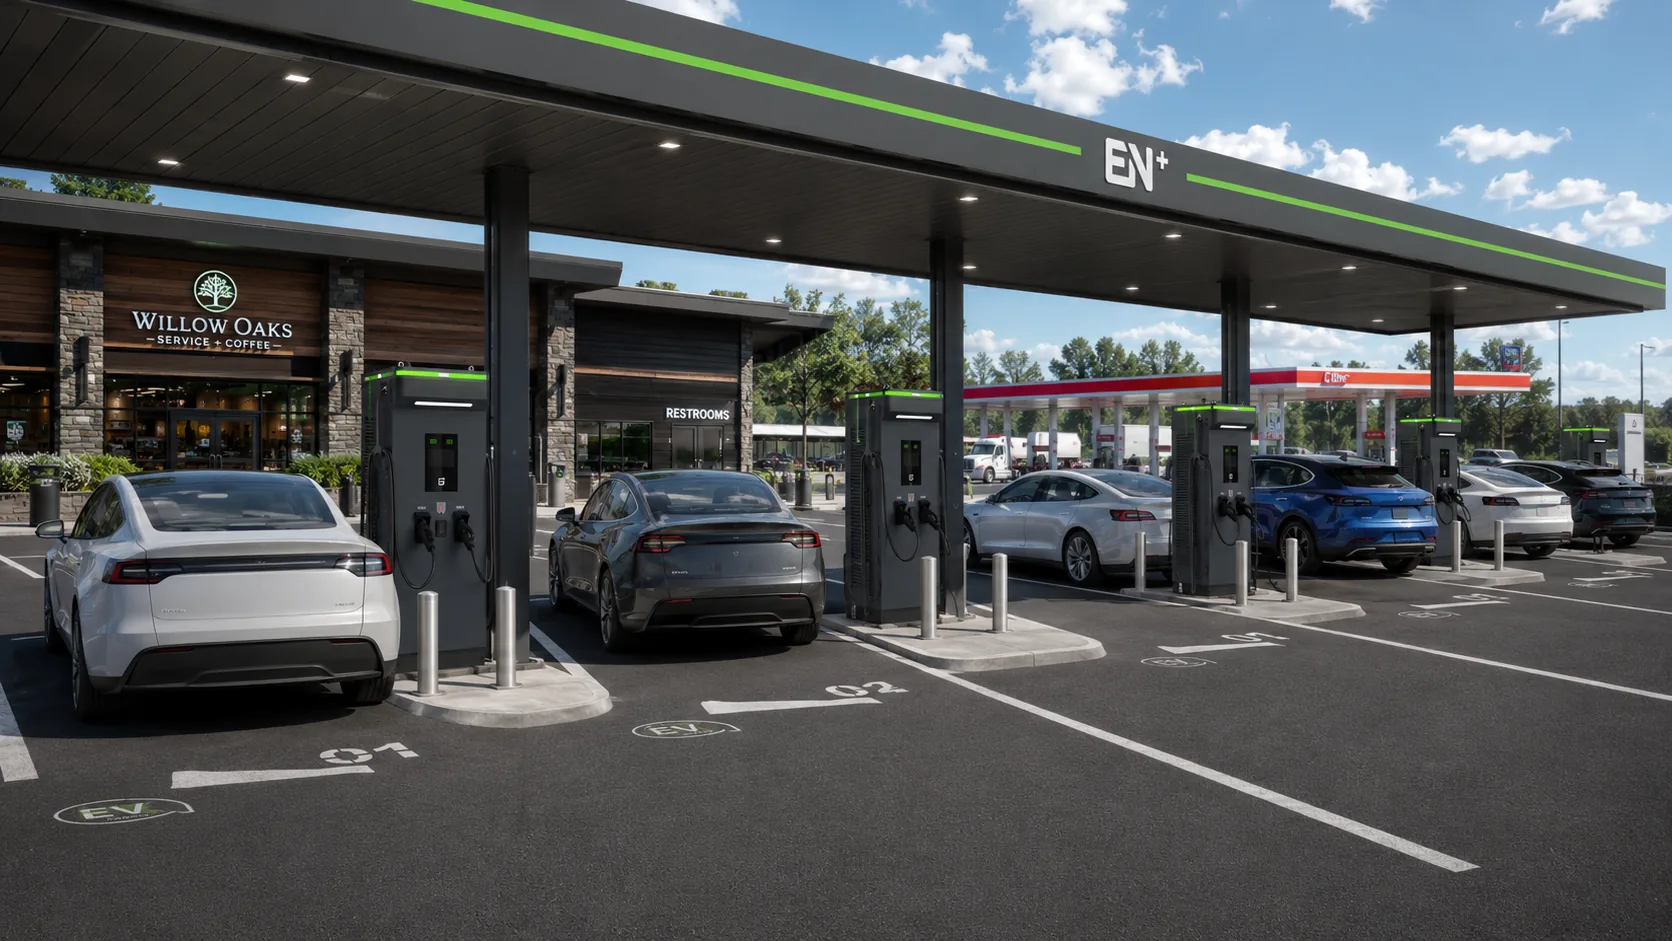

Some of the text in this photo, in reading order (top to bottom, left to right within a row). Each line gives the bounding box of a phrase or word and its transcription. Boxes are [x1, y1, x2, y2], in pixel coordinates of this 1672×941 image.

[157, 335, 210, 347] SERVICE
[225, 339, 271, 350] COFFEE
[666, 407, 730, 420] RESTROOMS
[825, 681, 909, 697] 02
[649, 723, 698, 736] EV
[319, 741, 420, 764] 01
[79, 802, 144, 820] EV
